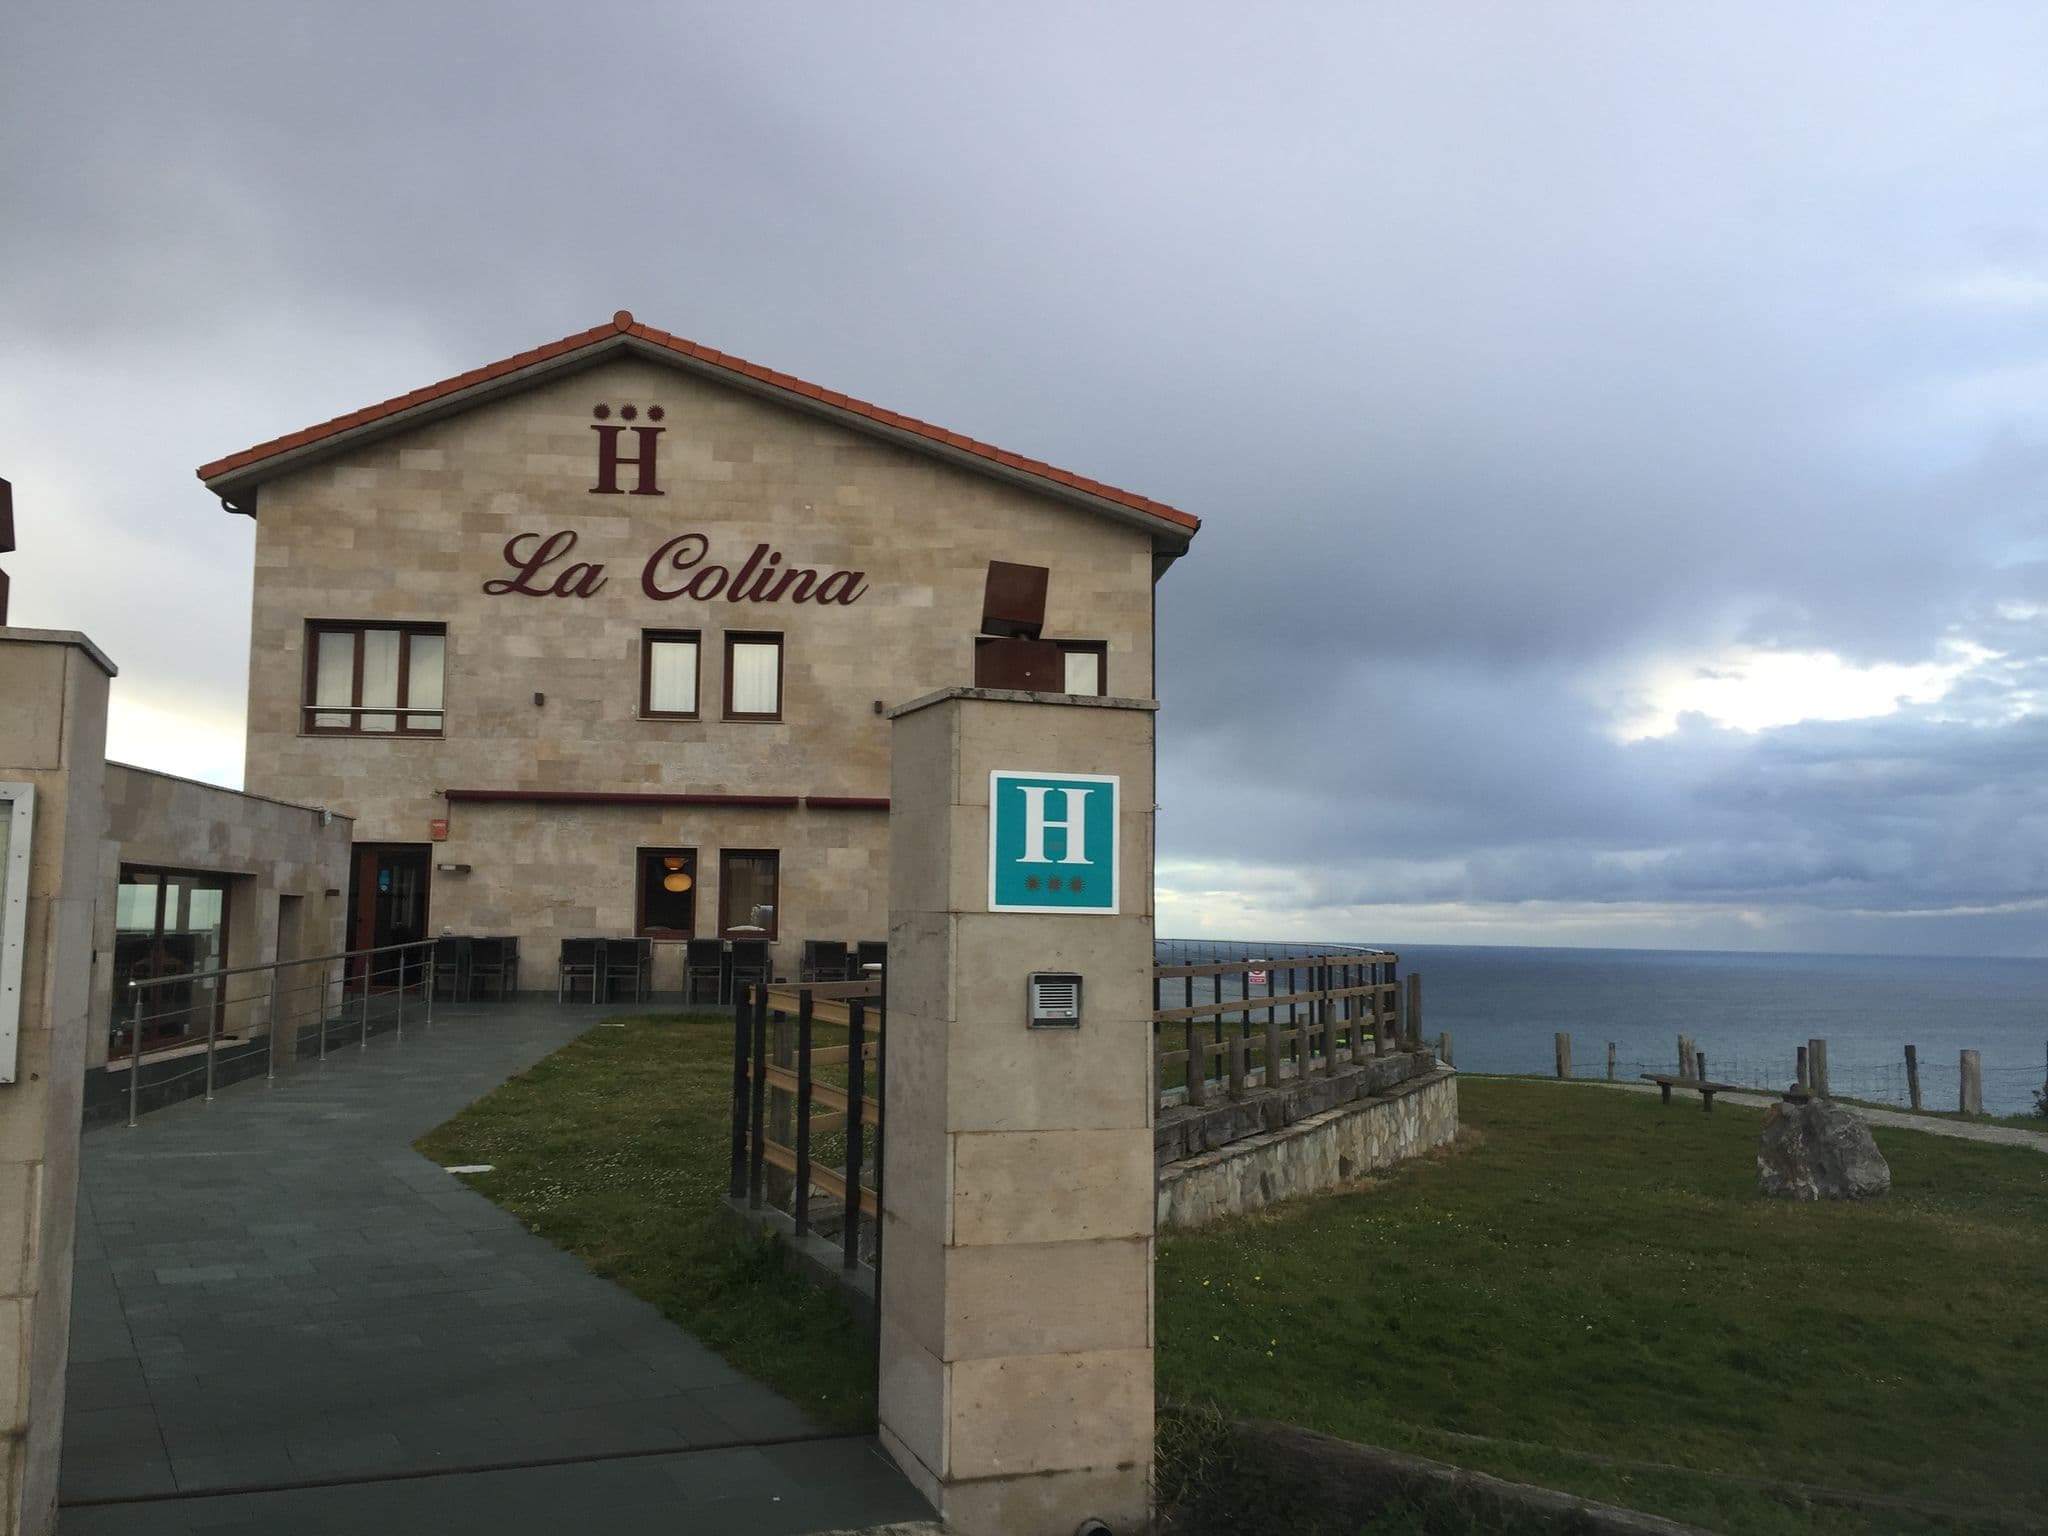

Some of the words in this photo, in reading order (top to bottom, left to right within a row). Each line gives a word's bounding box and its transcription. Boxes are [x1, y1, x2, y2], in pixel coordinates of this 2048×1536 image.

[588, 424, 667, 496] H
[482, 530, 608, 599] La
[641, 532, 869, 606] Colina
[1015, 785, 1095, 865] H
